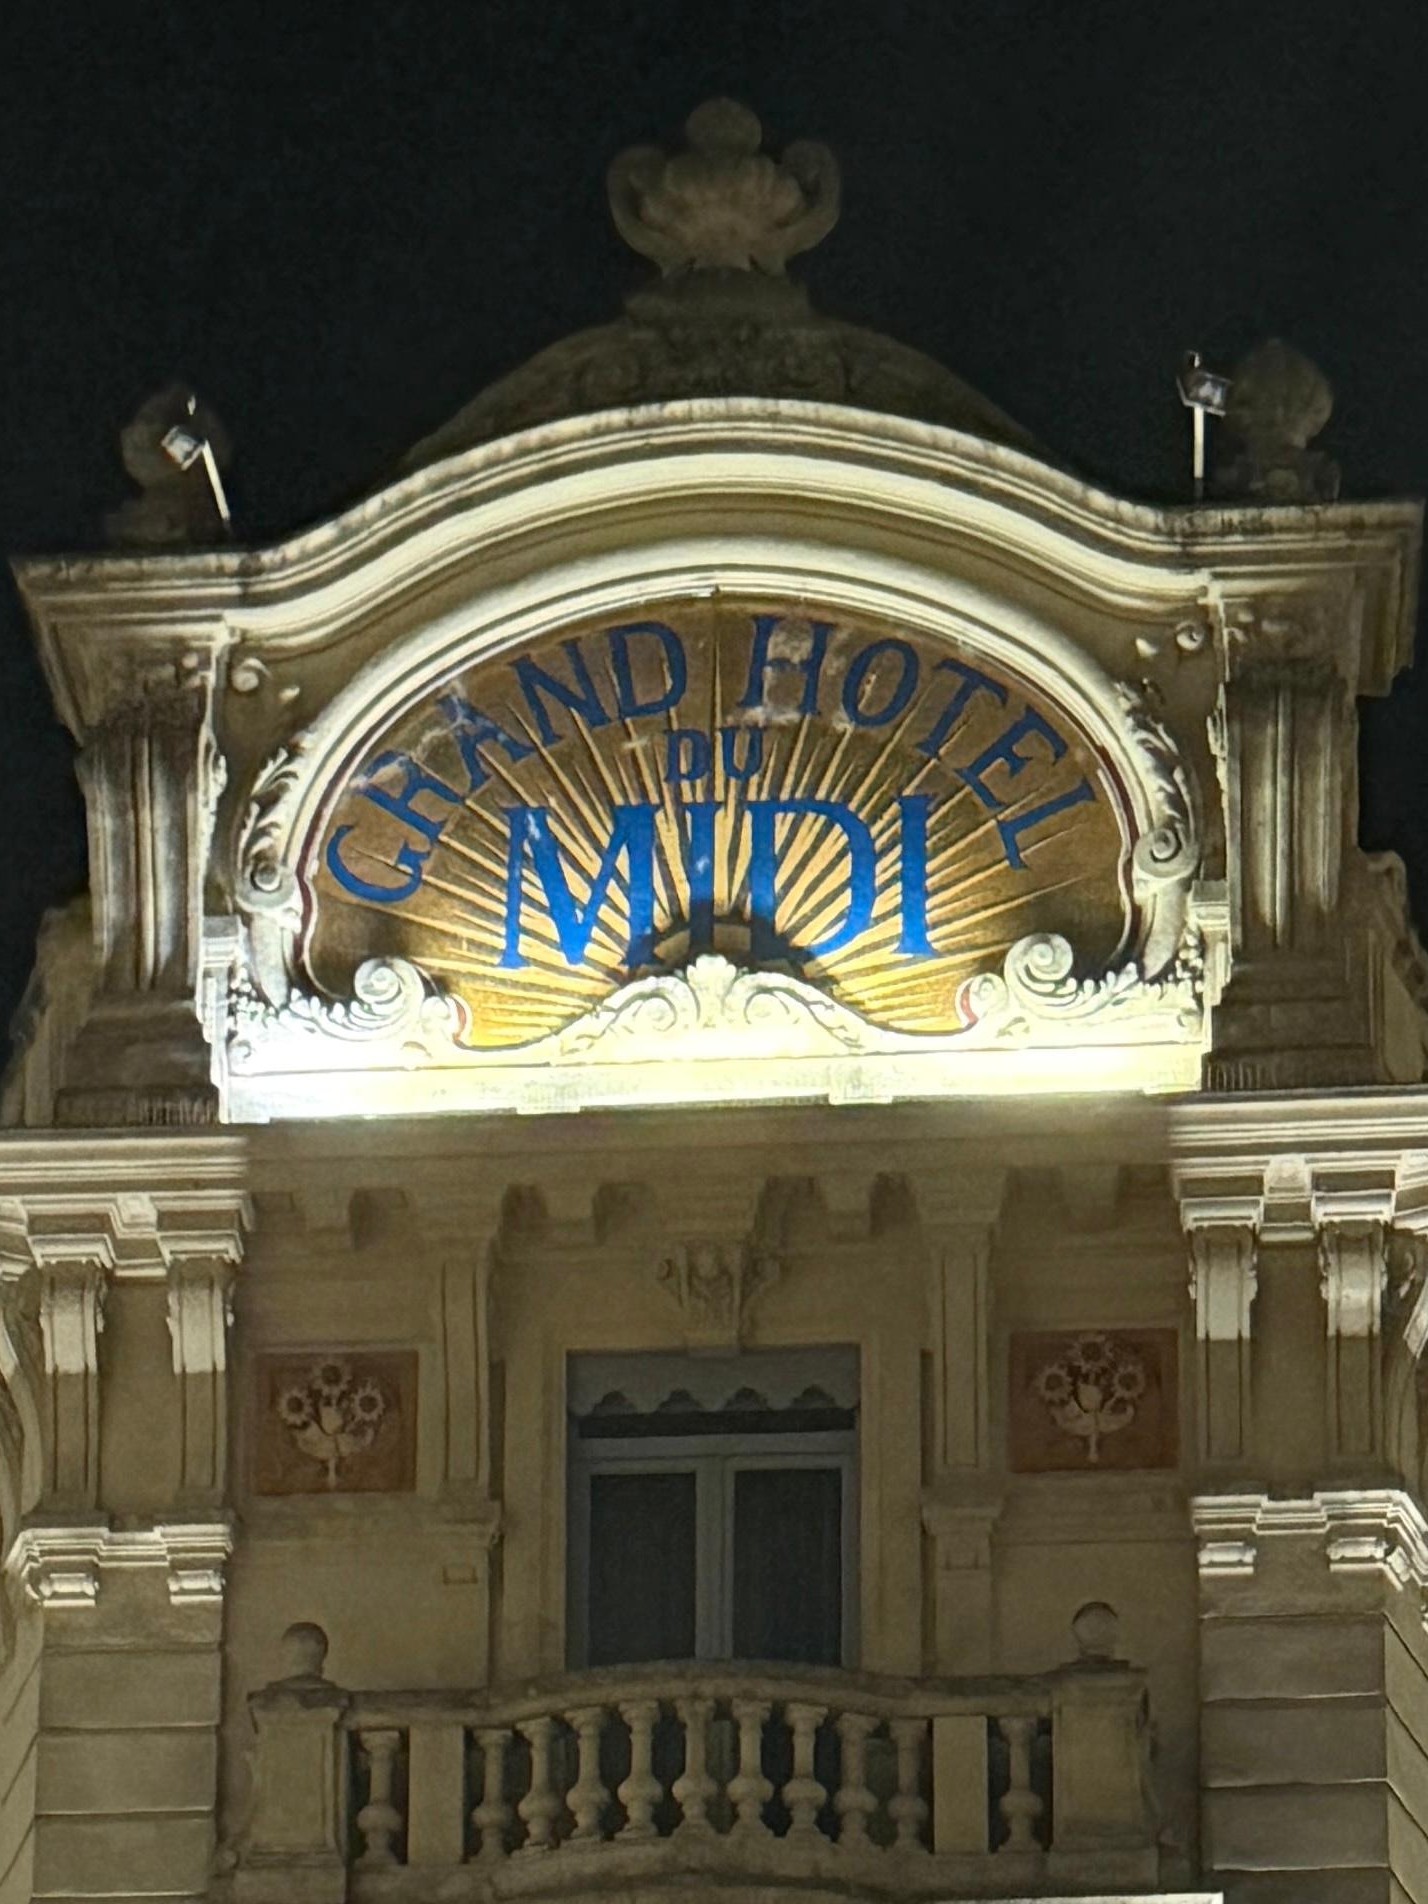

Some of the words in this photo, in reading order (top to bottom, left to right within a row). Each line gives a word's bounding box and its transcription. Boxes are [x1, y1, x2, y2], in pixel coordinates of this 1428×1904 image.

[326, 620, 688, 902] GRAND
[738, 615, 1097, 870] HOTEL
[663, 726, 766, 783] DU
[497, 794, 939, 968] MIDI
